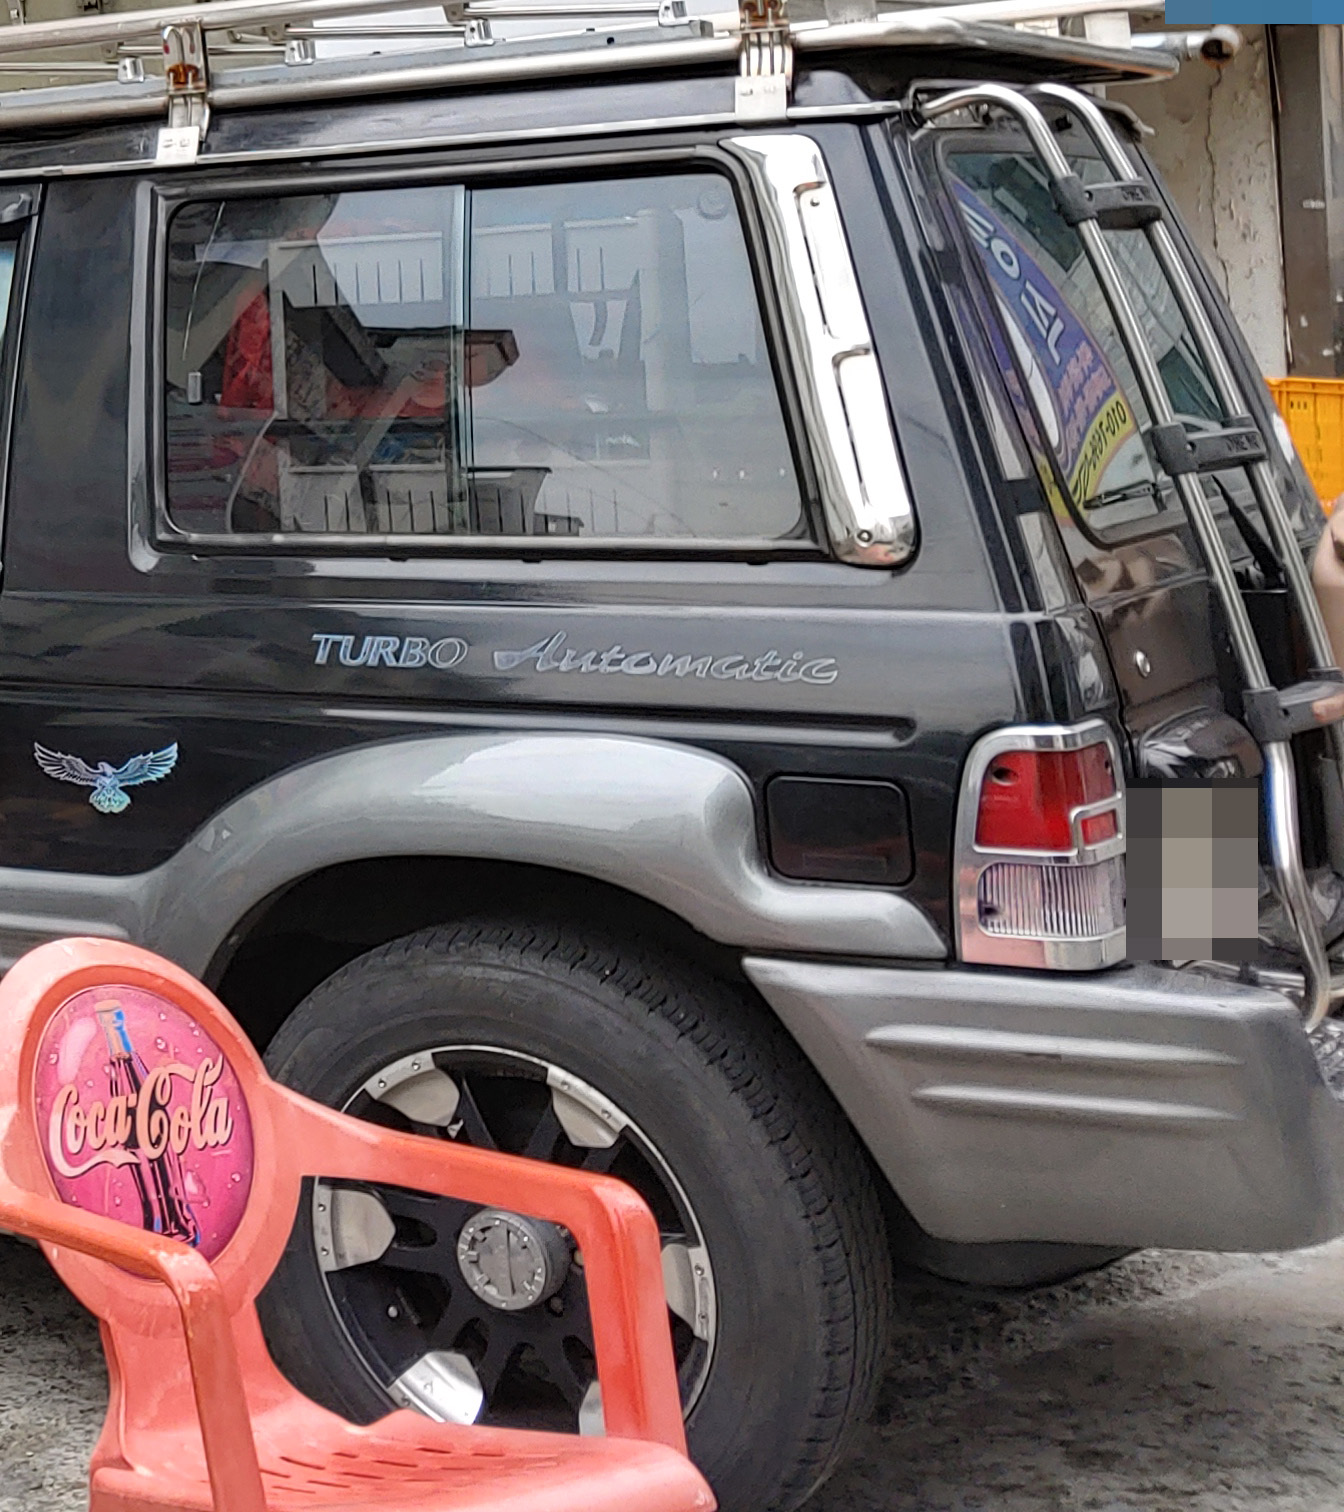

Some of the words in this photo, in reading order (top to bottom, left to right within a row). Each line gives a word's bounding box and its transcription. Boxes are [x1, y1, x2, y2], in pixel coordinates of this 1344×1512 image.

[312, 632, 469, 669] TURBO
[492, 630, 840, 684] Automatic
[49, 1053, 234, 1179] Coca-Cola
